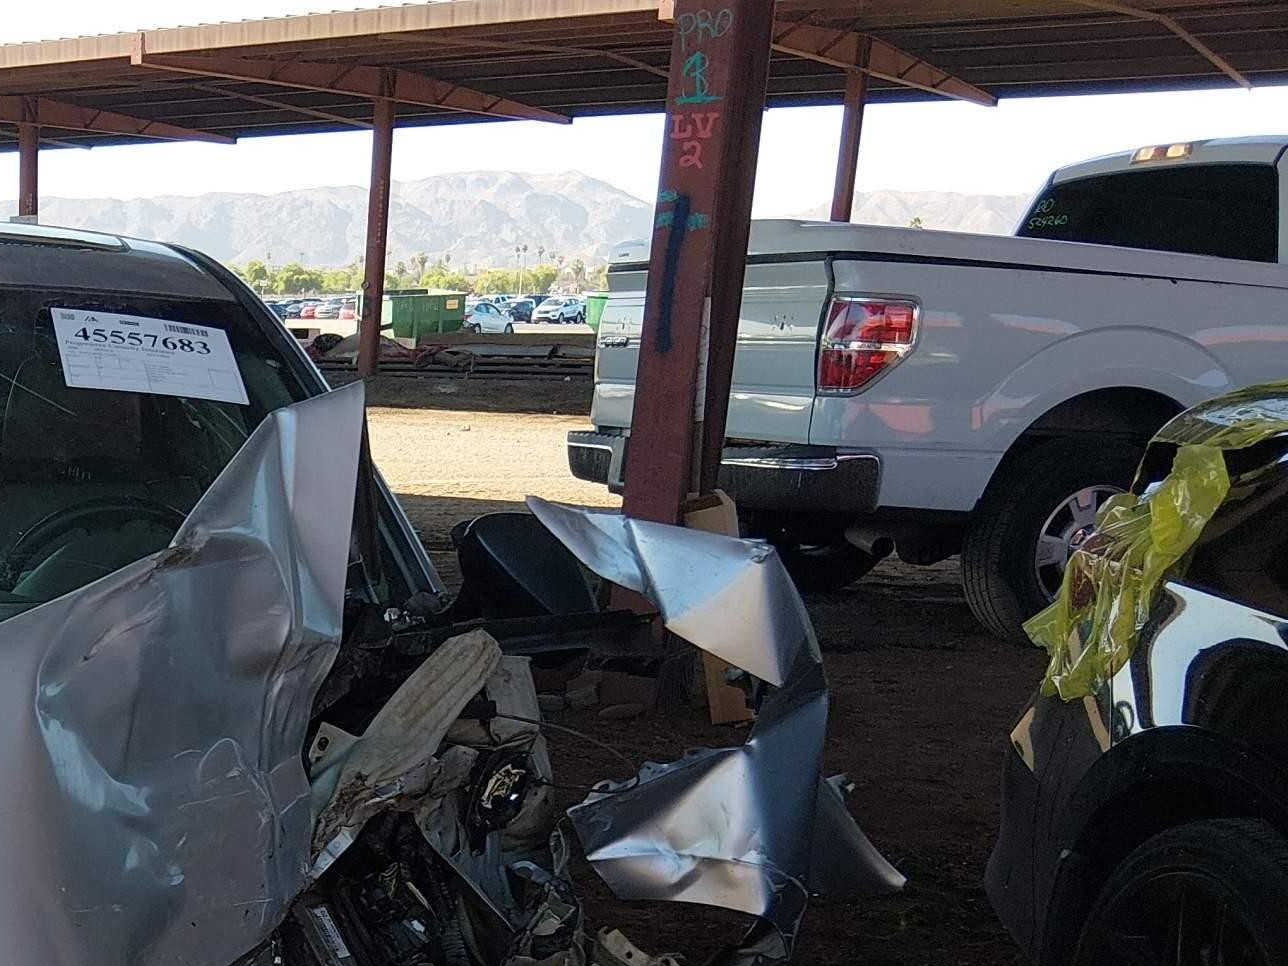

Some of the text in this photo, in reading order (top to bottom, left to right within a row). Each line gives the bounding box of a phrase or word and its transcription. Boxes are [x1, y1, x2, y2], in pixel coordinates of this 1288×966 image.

[677, 8, 733, 52] PRO
[670, 112, 720, 140] LV
[678, 140, 704, 169] 2
[74, 327, 211, 355] 45557683
